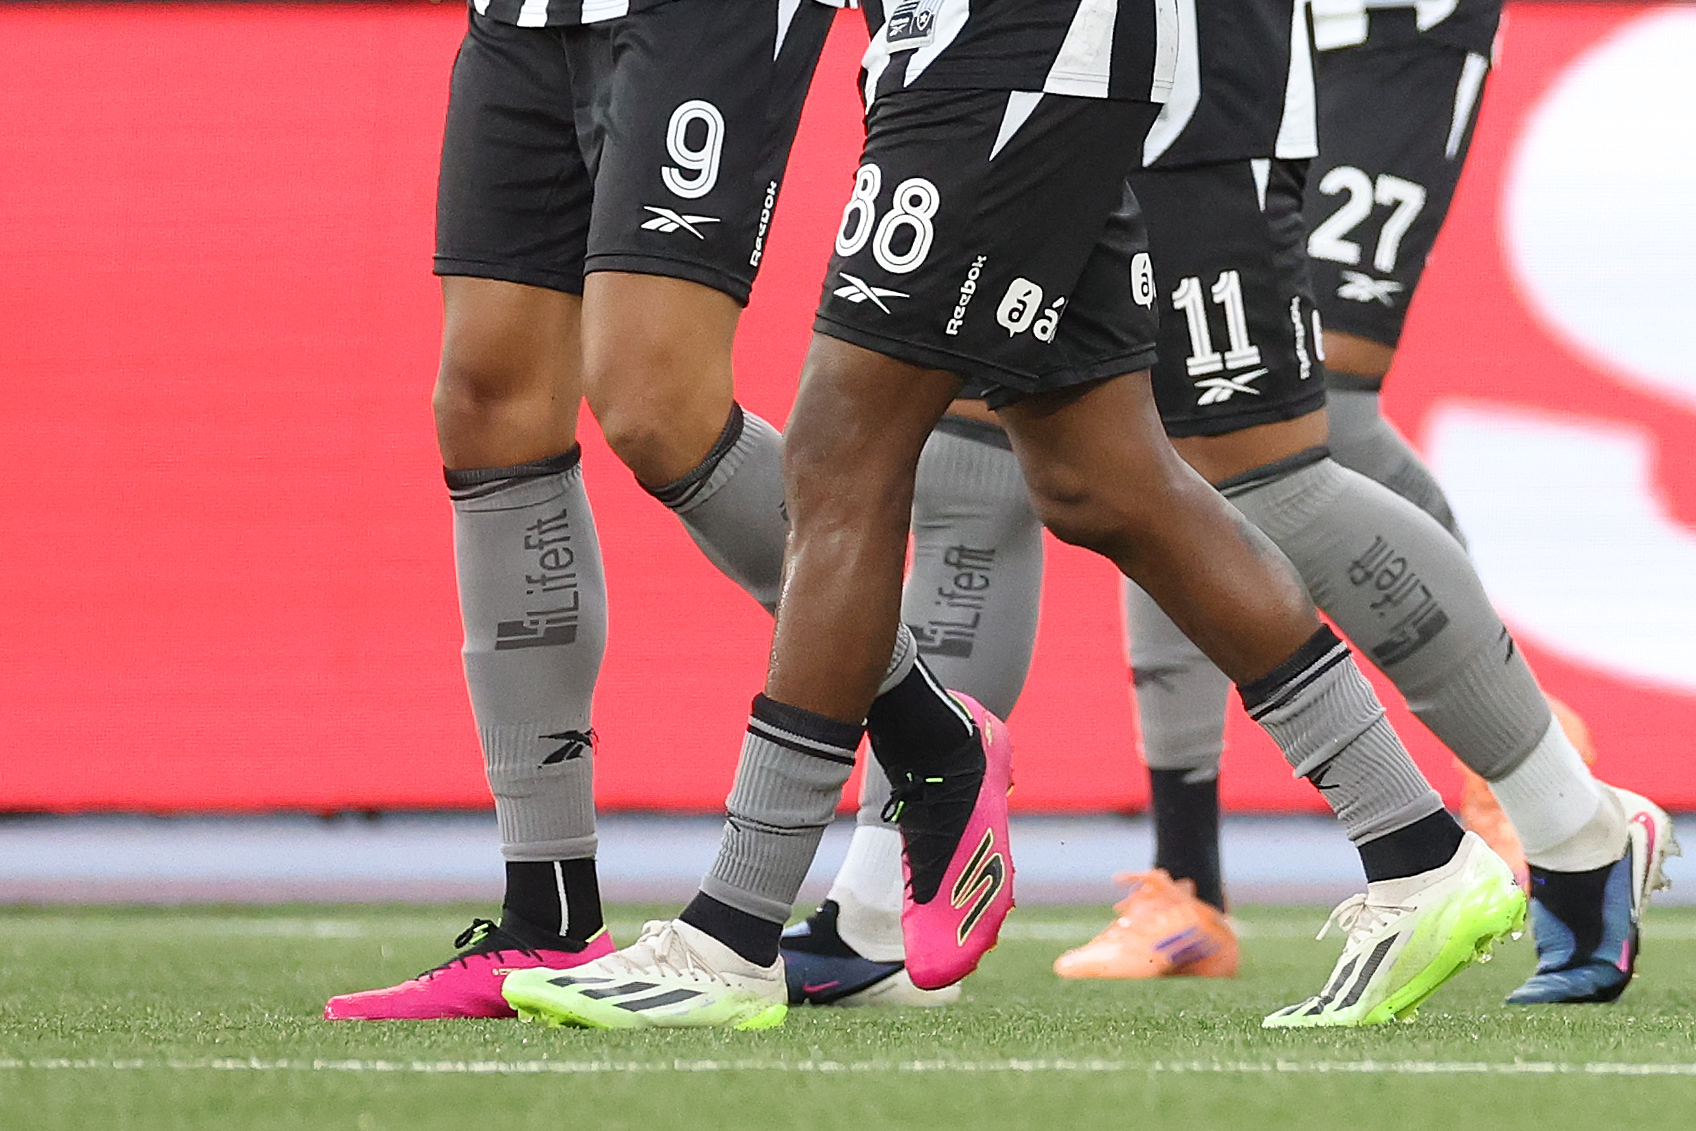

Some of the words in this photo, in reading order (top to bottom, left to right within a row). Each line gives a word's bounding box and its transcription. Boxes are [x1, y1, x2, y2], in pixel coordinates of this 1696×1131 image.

[661, 99, 725, 199] 9
[835, 163, 941, 274] 88
[1308, 165, 1427, 272] 27
[945, 255, 987, 336] Reebok
[1172, 270, 1262, 377] 11
